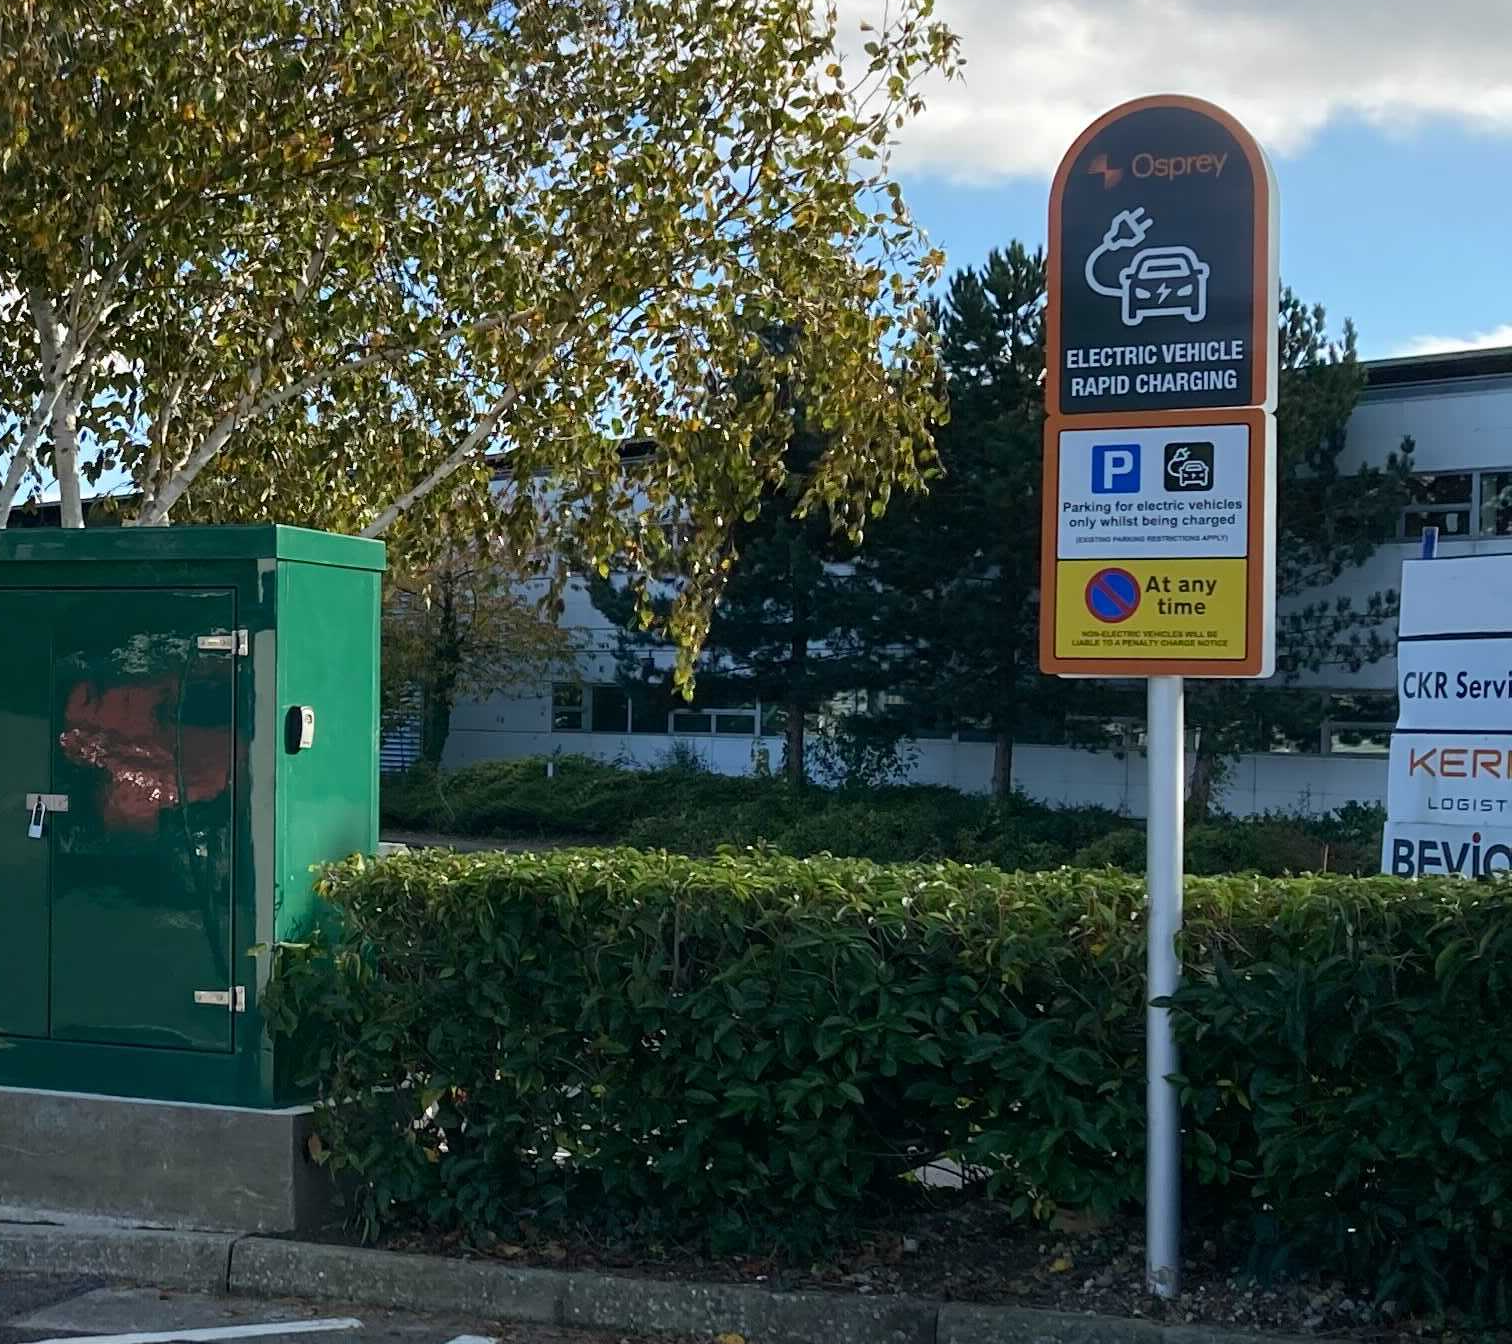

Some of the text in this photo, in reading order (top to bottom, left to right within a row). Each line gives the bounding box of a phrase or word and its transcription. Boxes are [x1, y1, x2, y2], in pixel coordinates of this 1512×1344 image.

[1131, 152, 1228, 182] Osprey
[1066, 340, 1244, 369] ELECTRIC VEHICLE
[1071, 369, 1237, 397] RAPID CHARGING
[1103, 450, 1133, 489] P
[1063, 499, 1243, 514] Parking for electric vehicles
[1069, 514, 1236, 529] only whilst being charged
[1145, 576, 1217, 596] At any
[1157, 598, 1206, 615] time
[1403, 671, 1448, 699] CKR
[1409, 748, 1512, 779] KER
[1427, 797, 1508, 812] LOGIST
